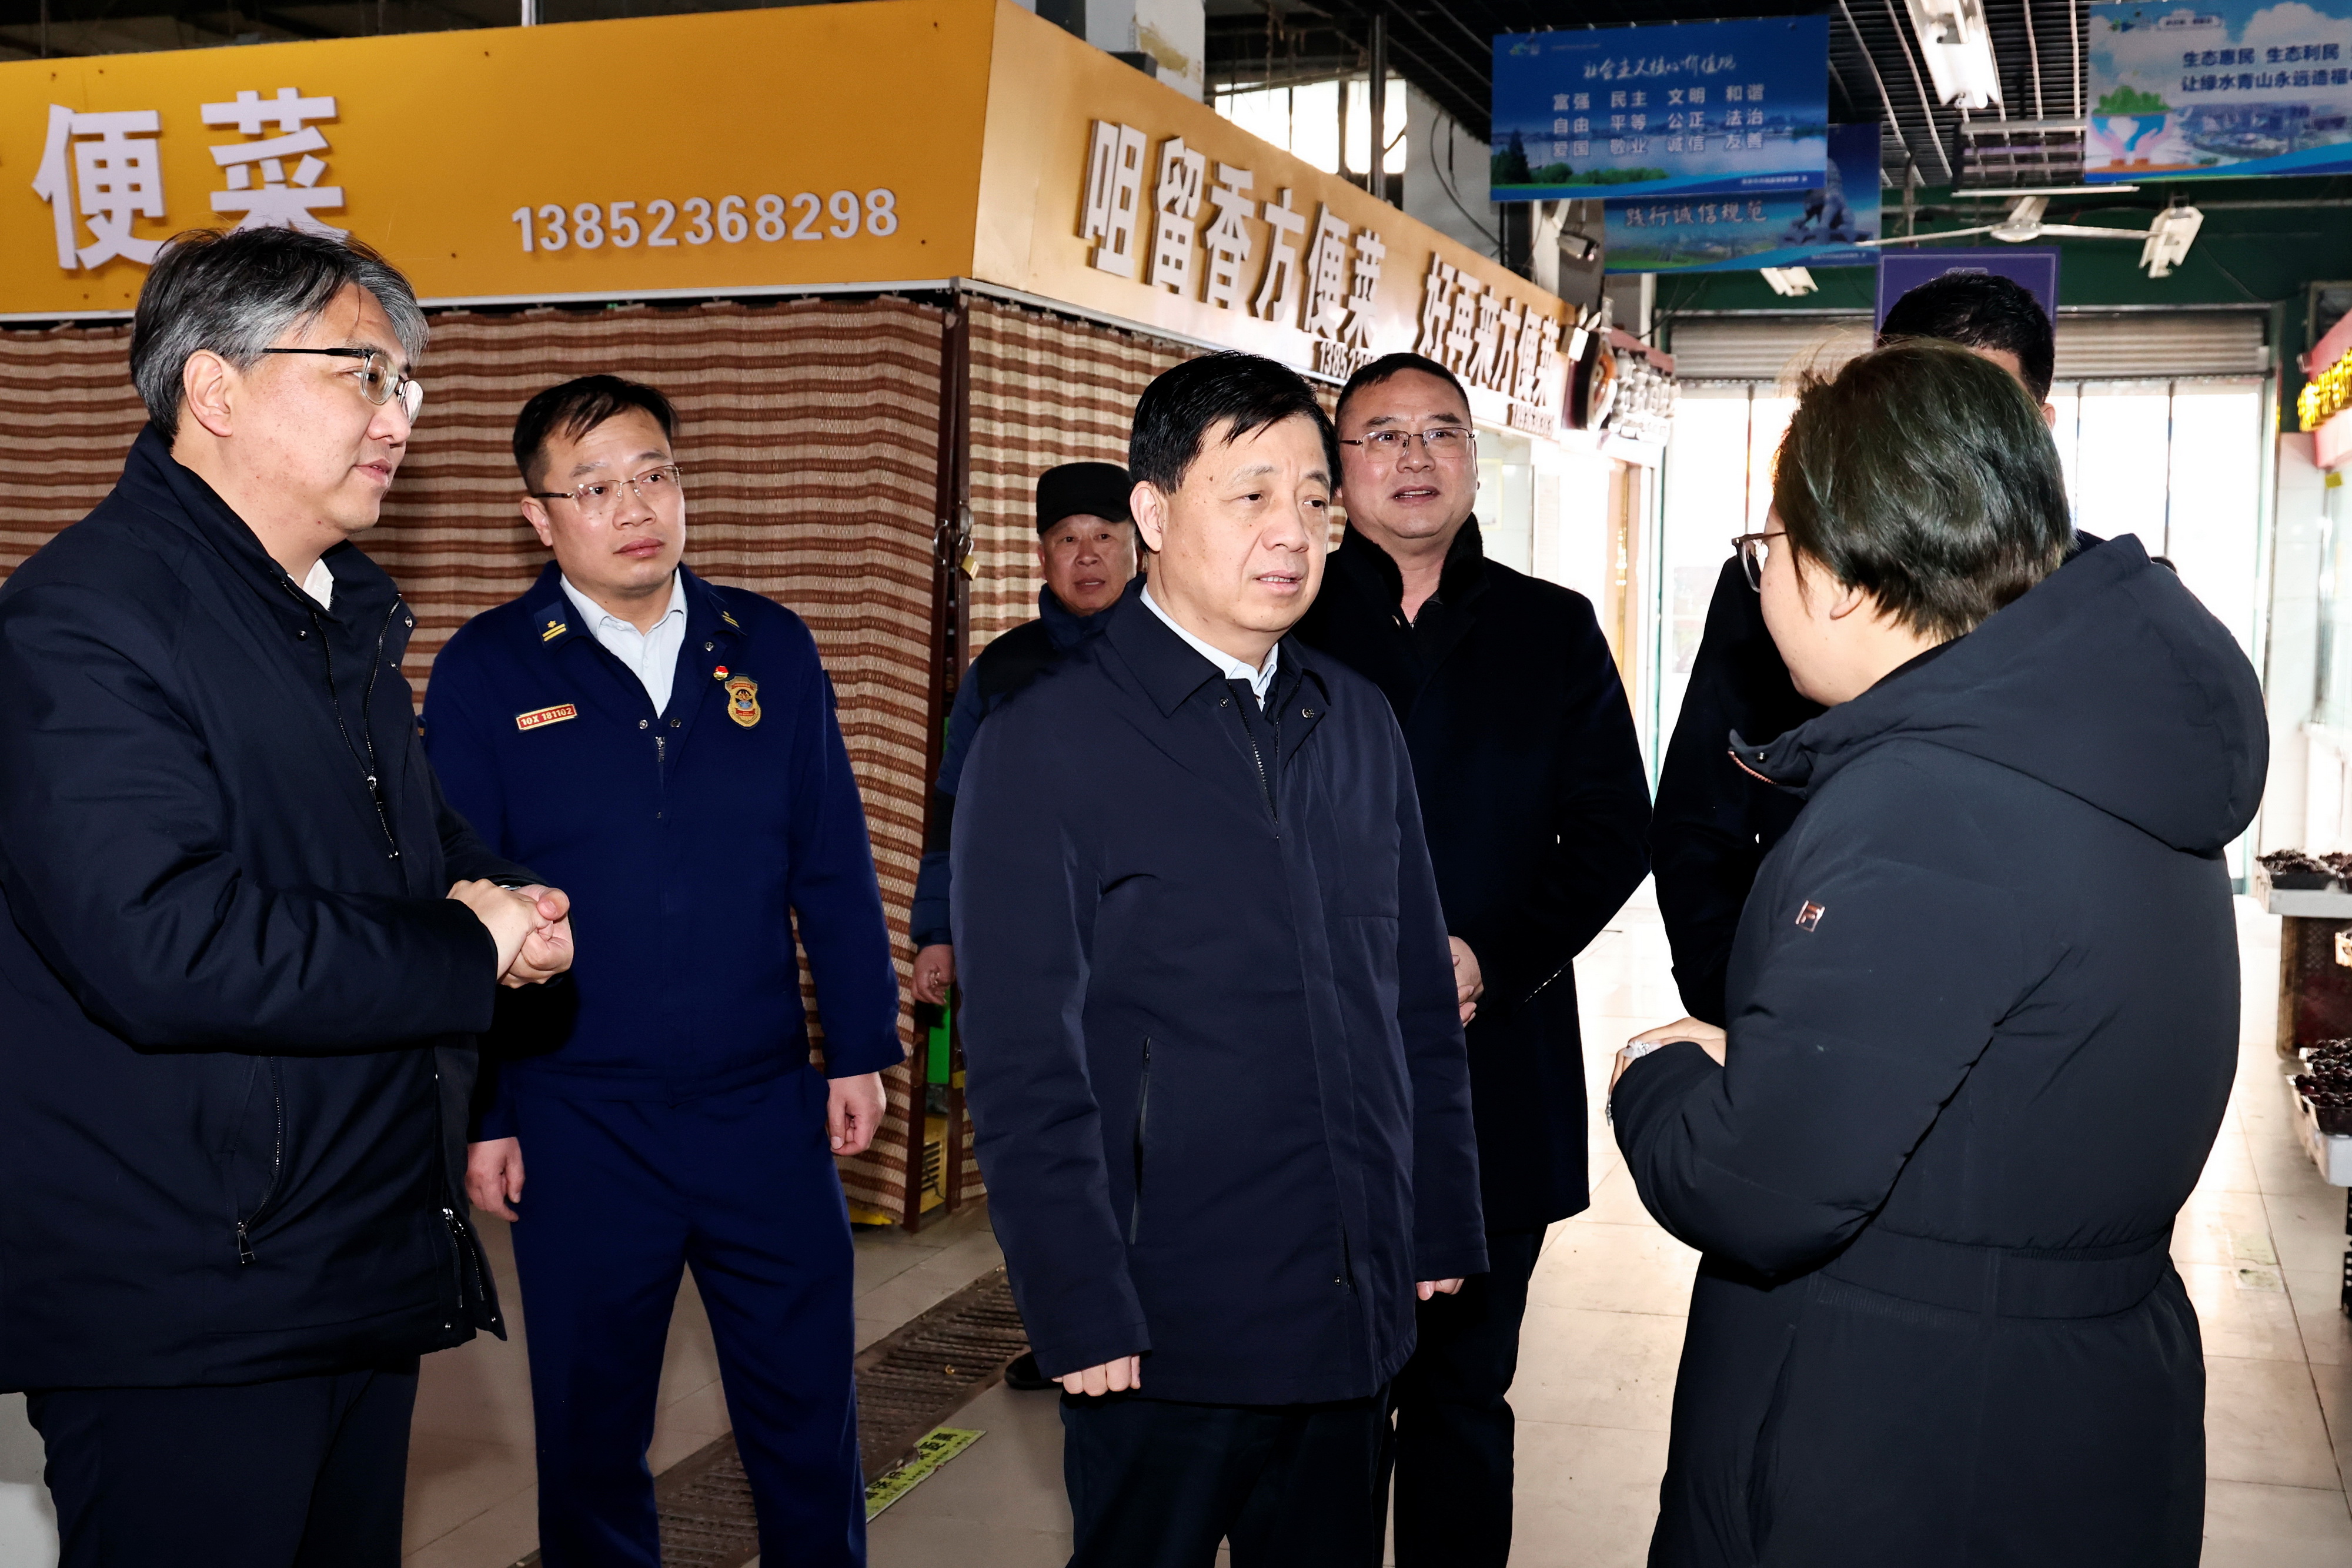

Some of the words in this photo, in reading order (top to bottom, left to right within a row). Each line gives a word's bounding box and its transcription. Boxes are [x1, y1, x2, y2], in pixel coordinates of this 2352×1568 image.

[1583, 53, 1736, 80] 社会主义核心价值观
[2182, 67, 2352, 92] 让绿水青山永远造福
[1553, 93, 1590, 111] 富强
[1611, 90, 1647, 108] 民主
[1668, 87, 1705, 106] 文明
[1726, 83, 1764, 102] 和谐
[1554, 116, 1589, 134] 自由
[1611, 113, 1646, 131] 平等
[1668, 111, 1704, 129] 公正
[1725, 108, 1763, 126] 法治
[1553, 140, 1589, 157] 爱国
[1611, 137, 1647, 155] 敬业
[1668, 135, 1704, 152] 诚信
[1725, 132, 1762, 148] 友善
[32, 87, 350, 269] 便菜
[512, 188, 898, 252] 13852368298
[1626, 200, 1766, 227] 践行诚信规范
[1080, 119, 1386, 348] 咀留香方便菜
[1416, 252, 1560, 407] 好再来方便菜
[520, 715, 540, 726] 10X
[541, 707, 573, 720] 181102
